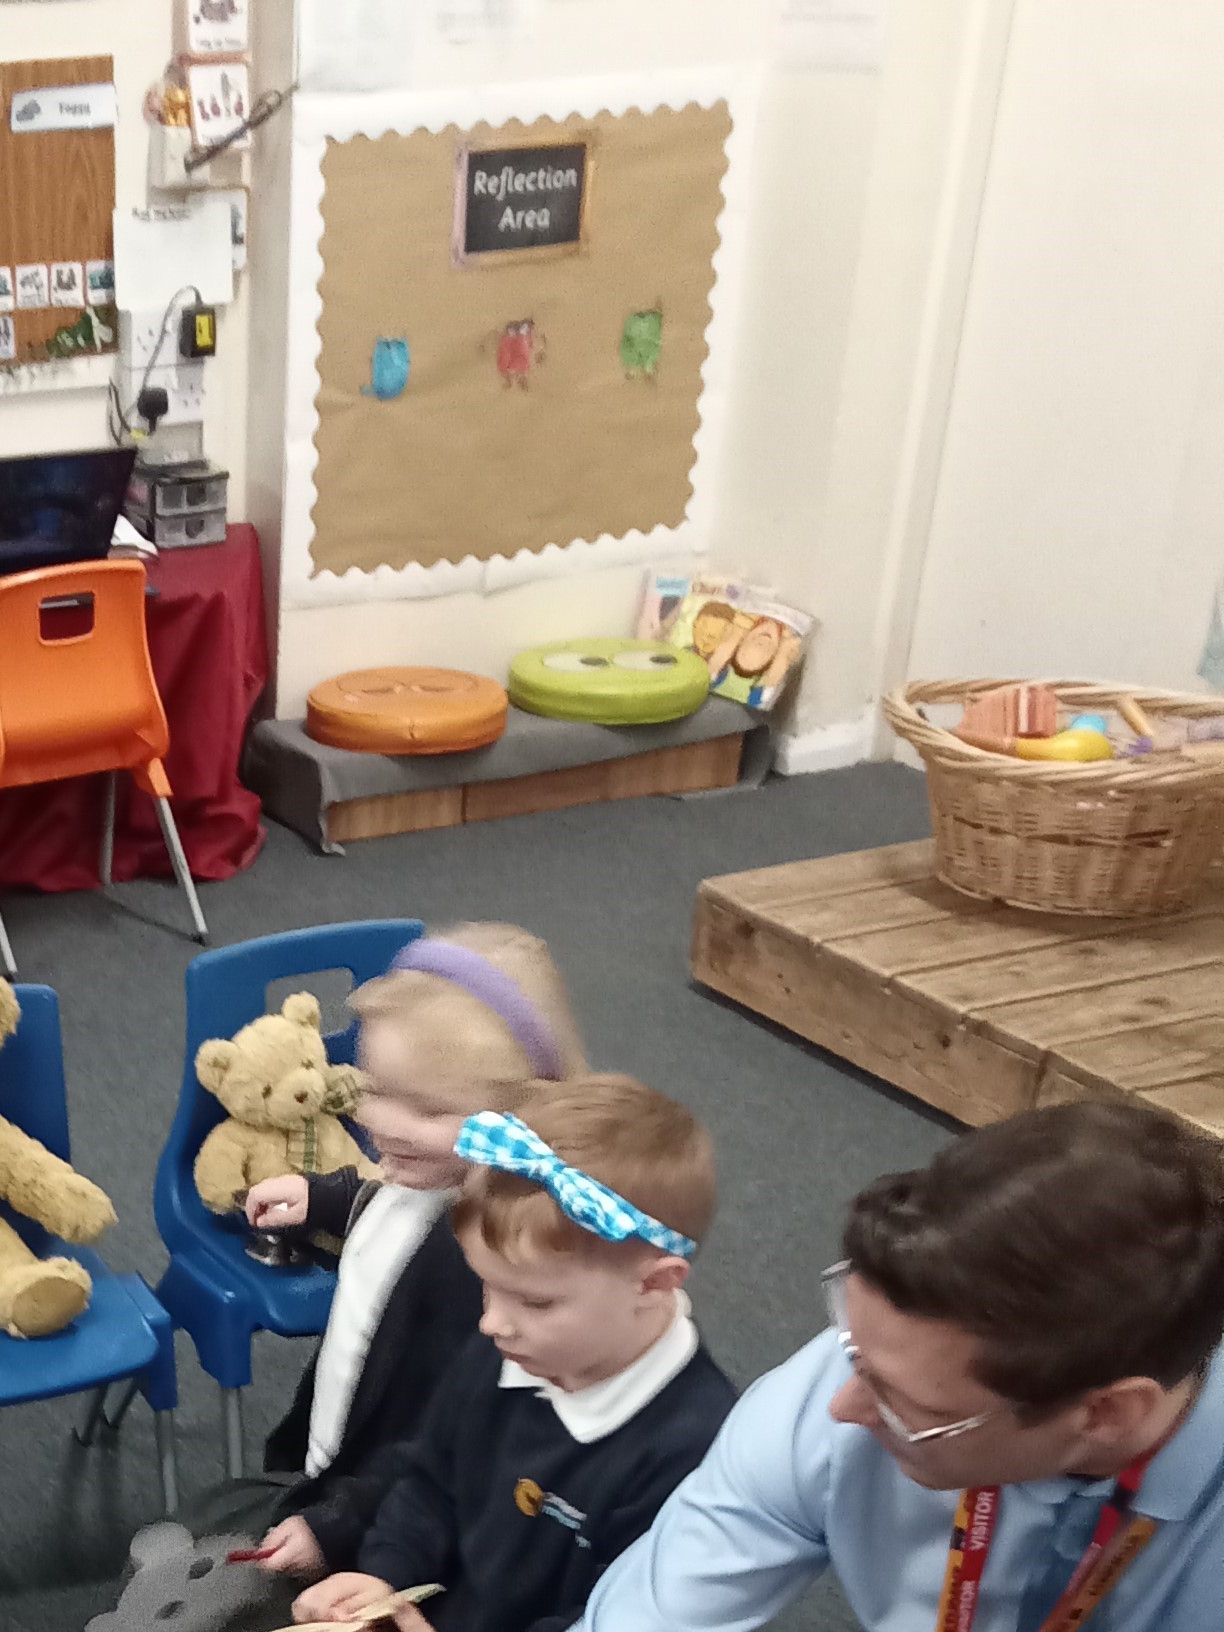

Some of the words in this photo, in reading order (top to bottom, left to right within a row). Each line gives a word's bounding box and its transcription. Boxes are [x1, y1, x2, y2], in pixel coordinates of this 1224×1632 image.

[474, 165, 578, 201] Reflection
[498, 205, 551, 232] Area
[970, 1491, 996, 1551] VISITOR
